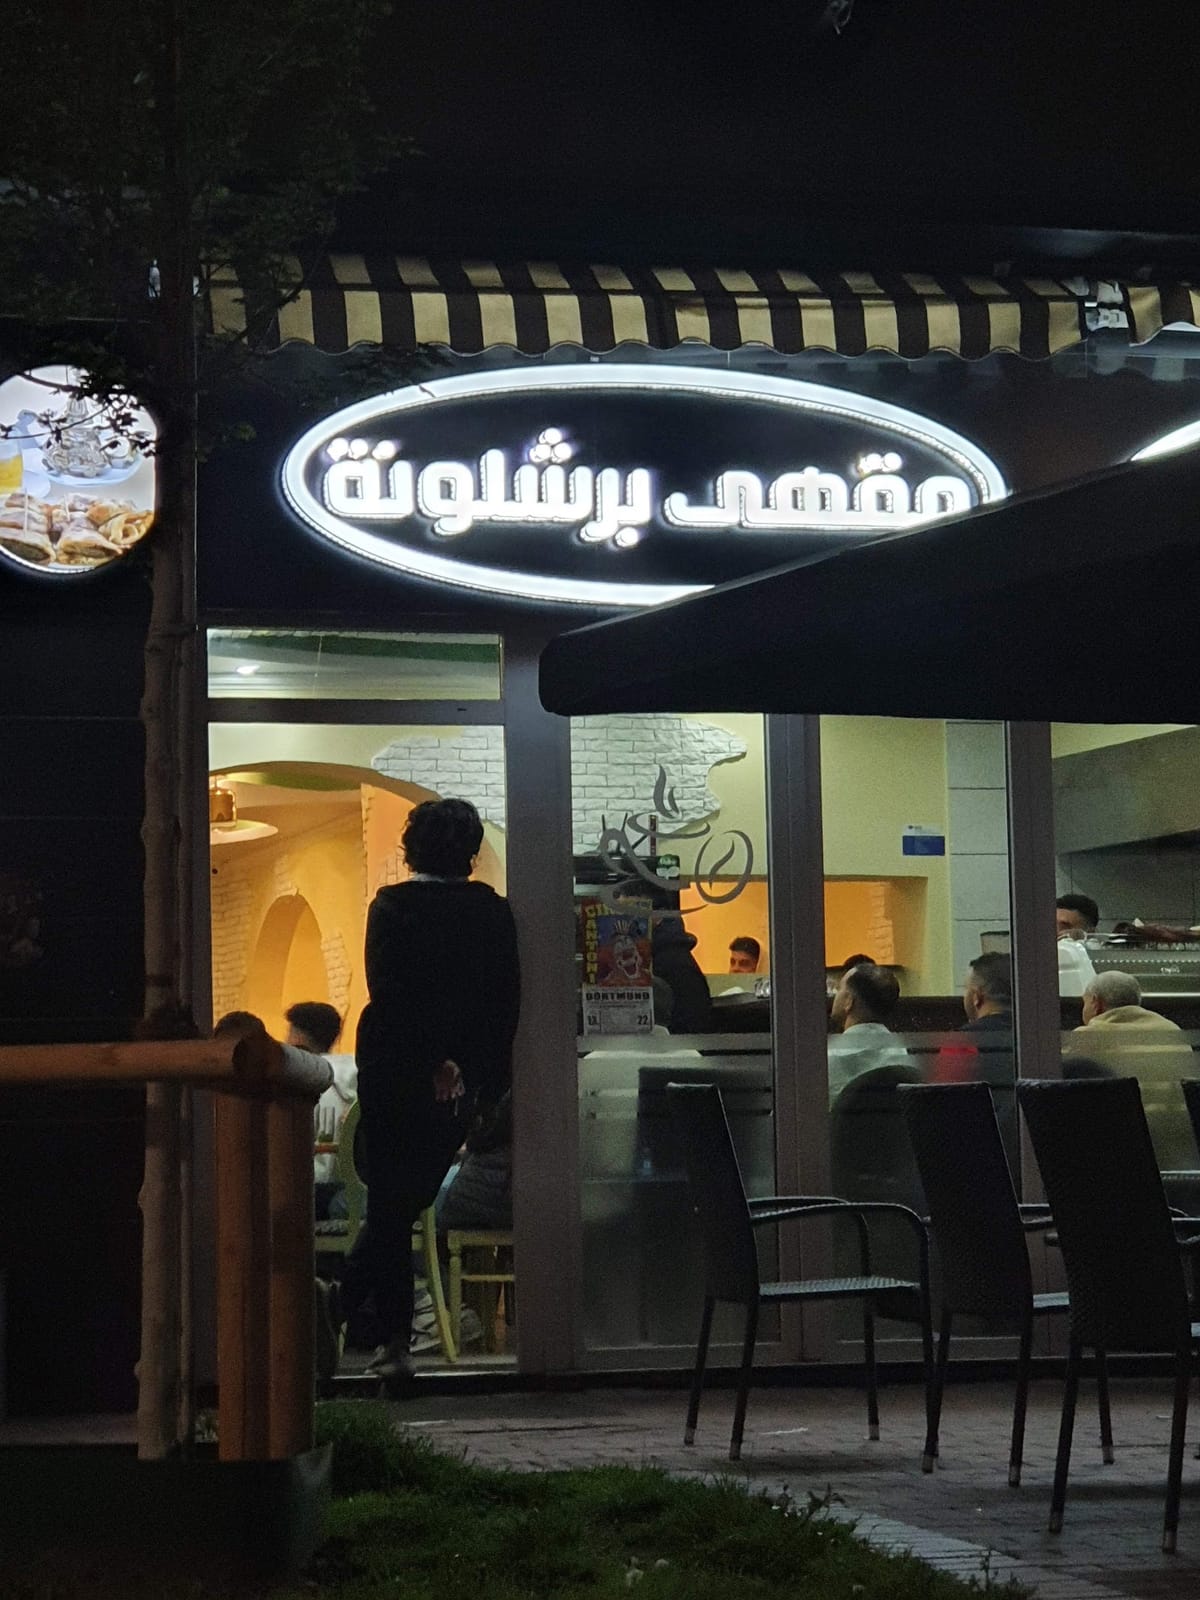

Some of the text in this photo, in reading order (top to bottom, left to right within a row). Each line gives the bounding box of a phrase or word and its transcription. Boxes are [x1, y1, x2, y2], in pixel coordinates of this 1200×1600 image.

[323, 427, 972, 547] مقهى برشلونة
[586, 992, 650, 1000] DORTMUND
